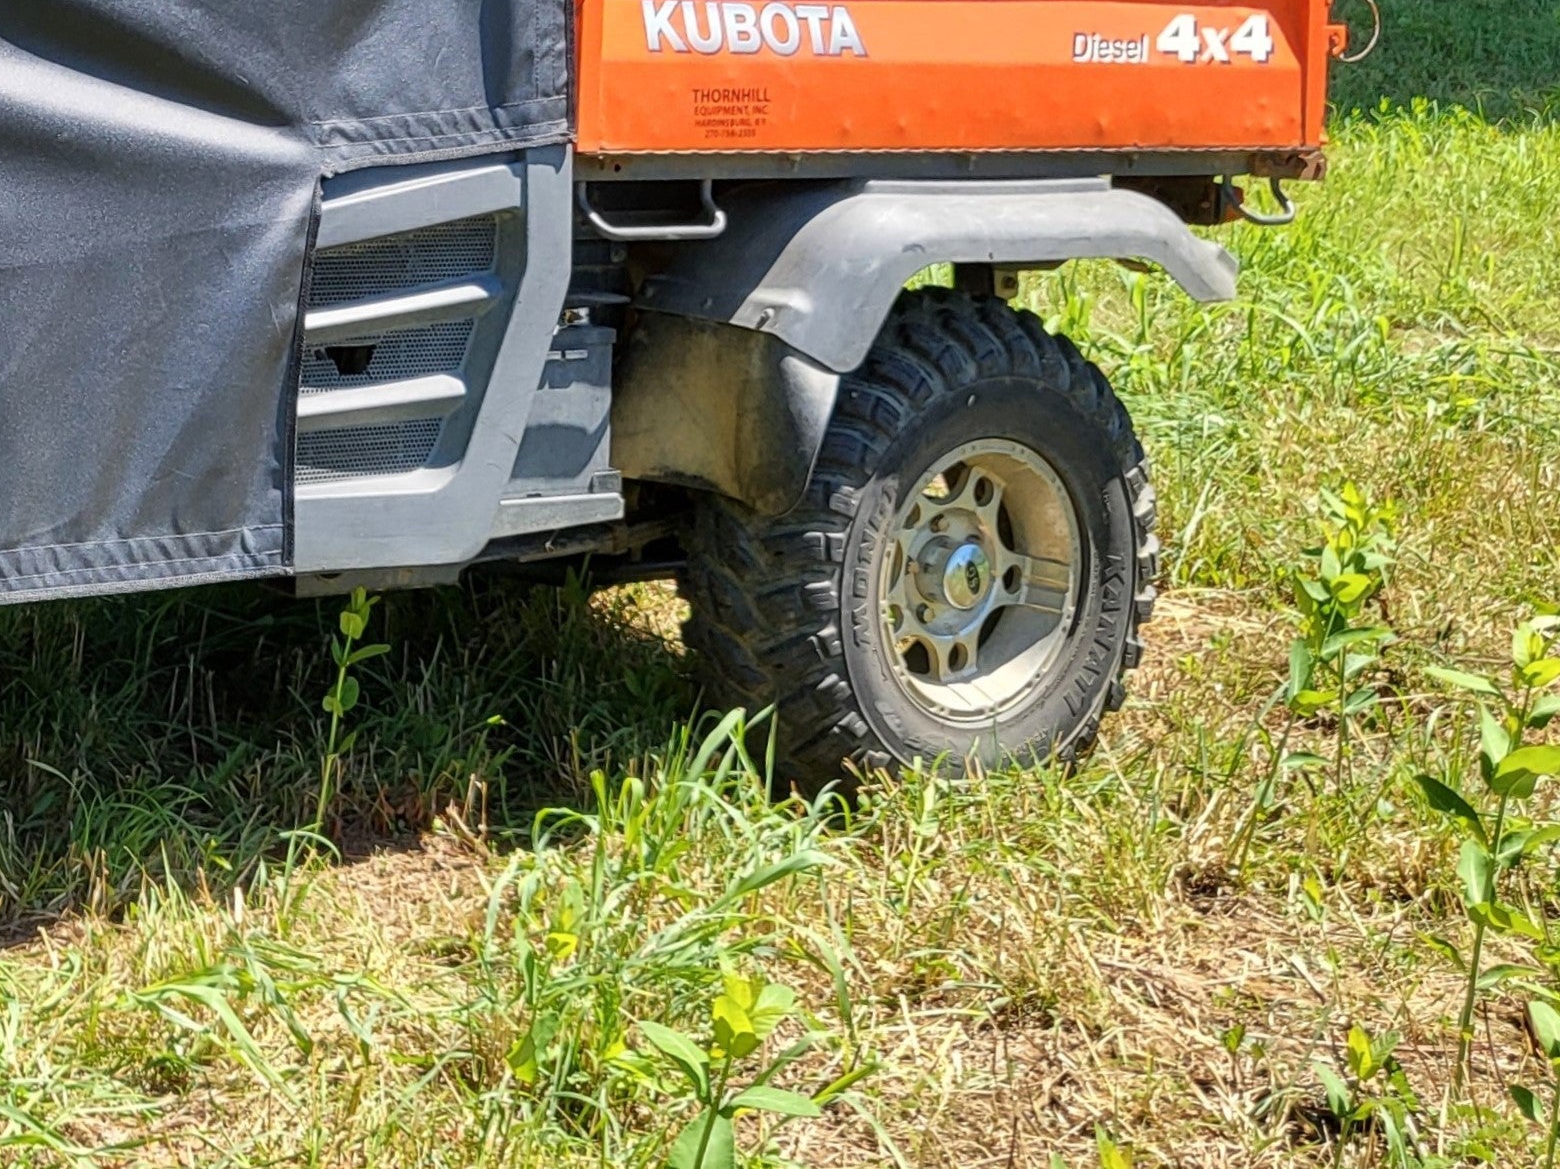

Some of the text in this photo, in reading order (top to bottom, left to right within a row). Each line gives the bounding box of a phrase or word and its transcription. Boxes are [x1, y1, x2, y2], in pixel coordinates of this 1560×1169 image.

[1072, 13, 1273, 64] Diesel 4x4
[692, 87, 771, 103] THORNHILL
